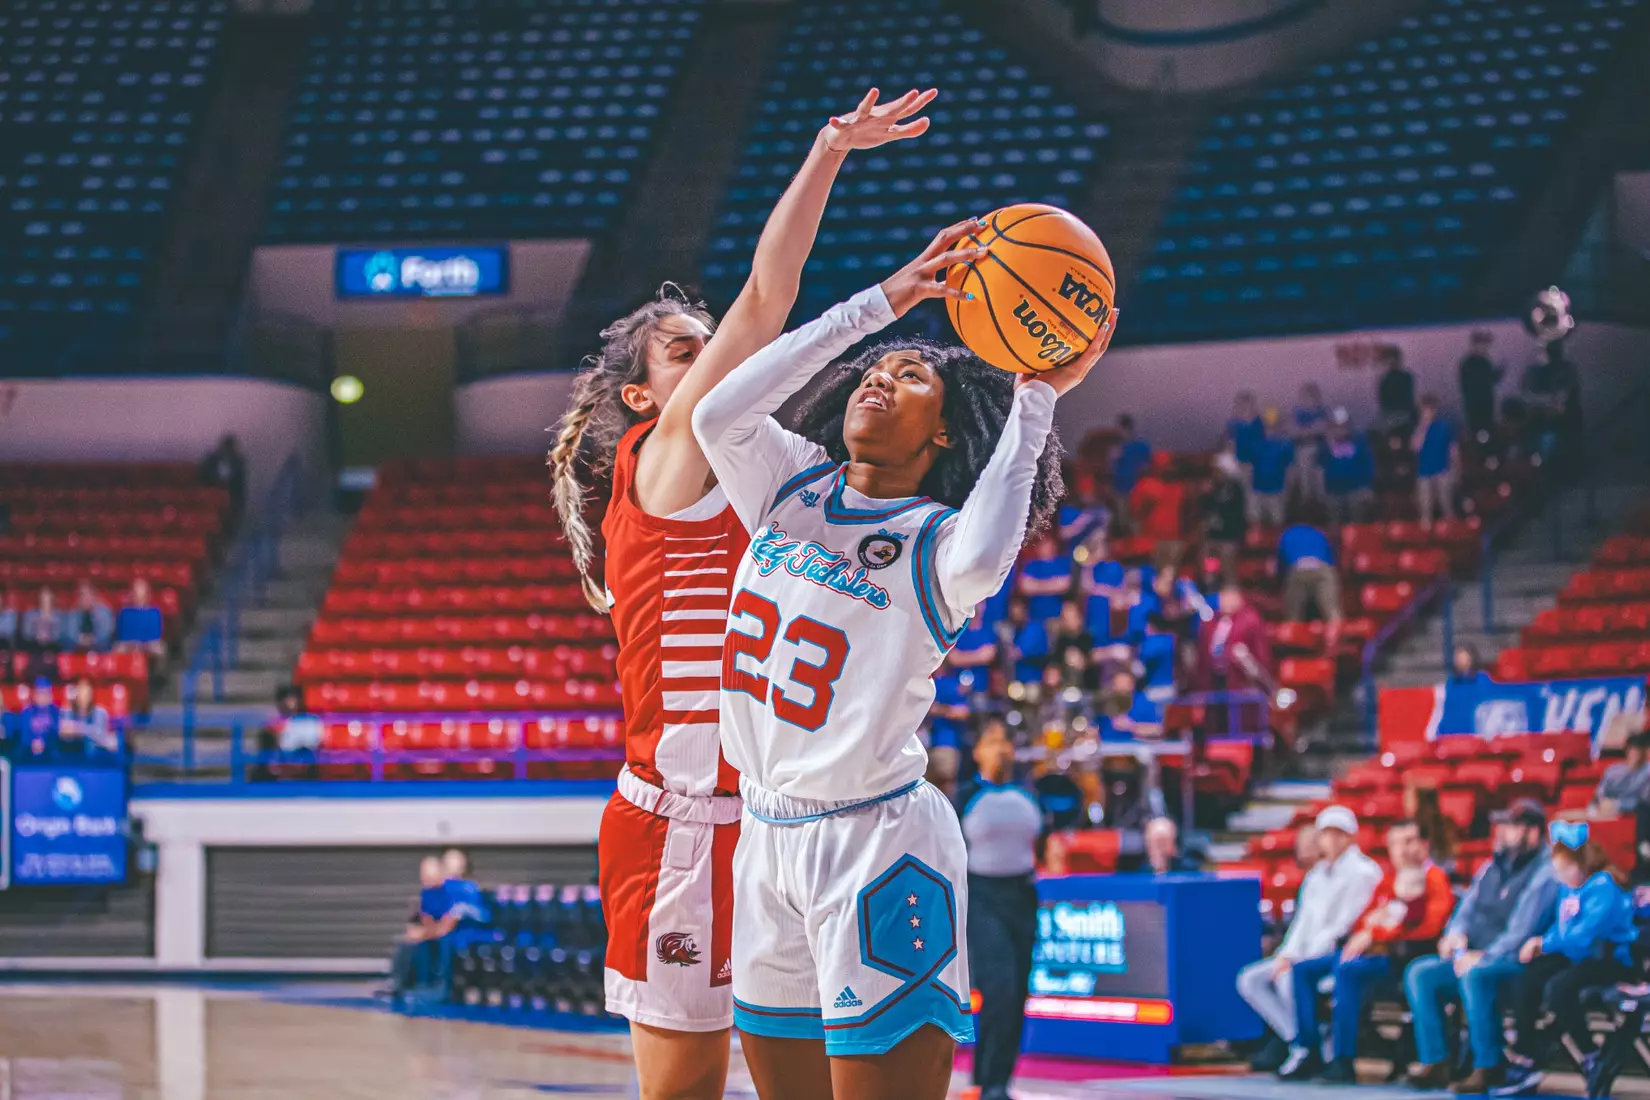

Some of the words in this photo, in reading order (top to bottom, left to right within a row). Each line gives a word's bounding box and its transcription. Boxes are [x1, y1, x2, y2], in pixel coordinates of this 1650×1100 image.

[1057, 271, 1110, 325] NCAA
[784, 540, 892, 610] Techsters
[721, 587, 851, 733] 23
[717, 969, 732, 979] adid
[833, 999, 863, 1008] adidas
